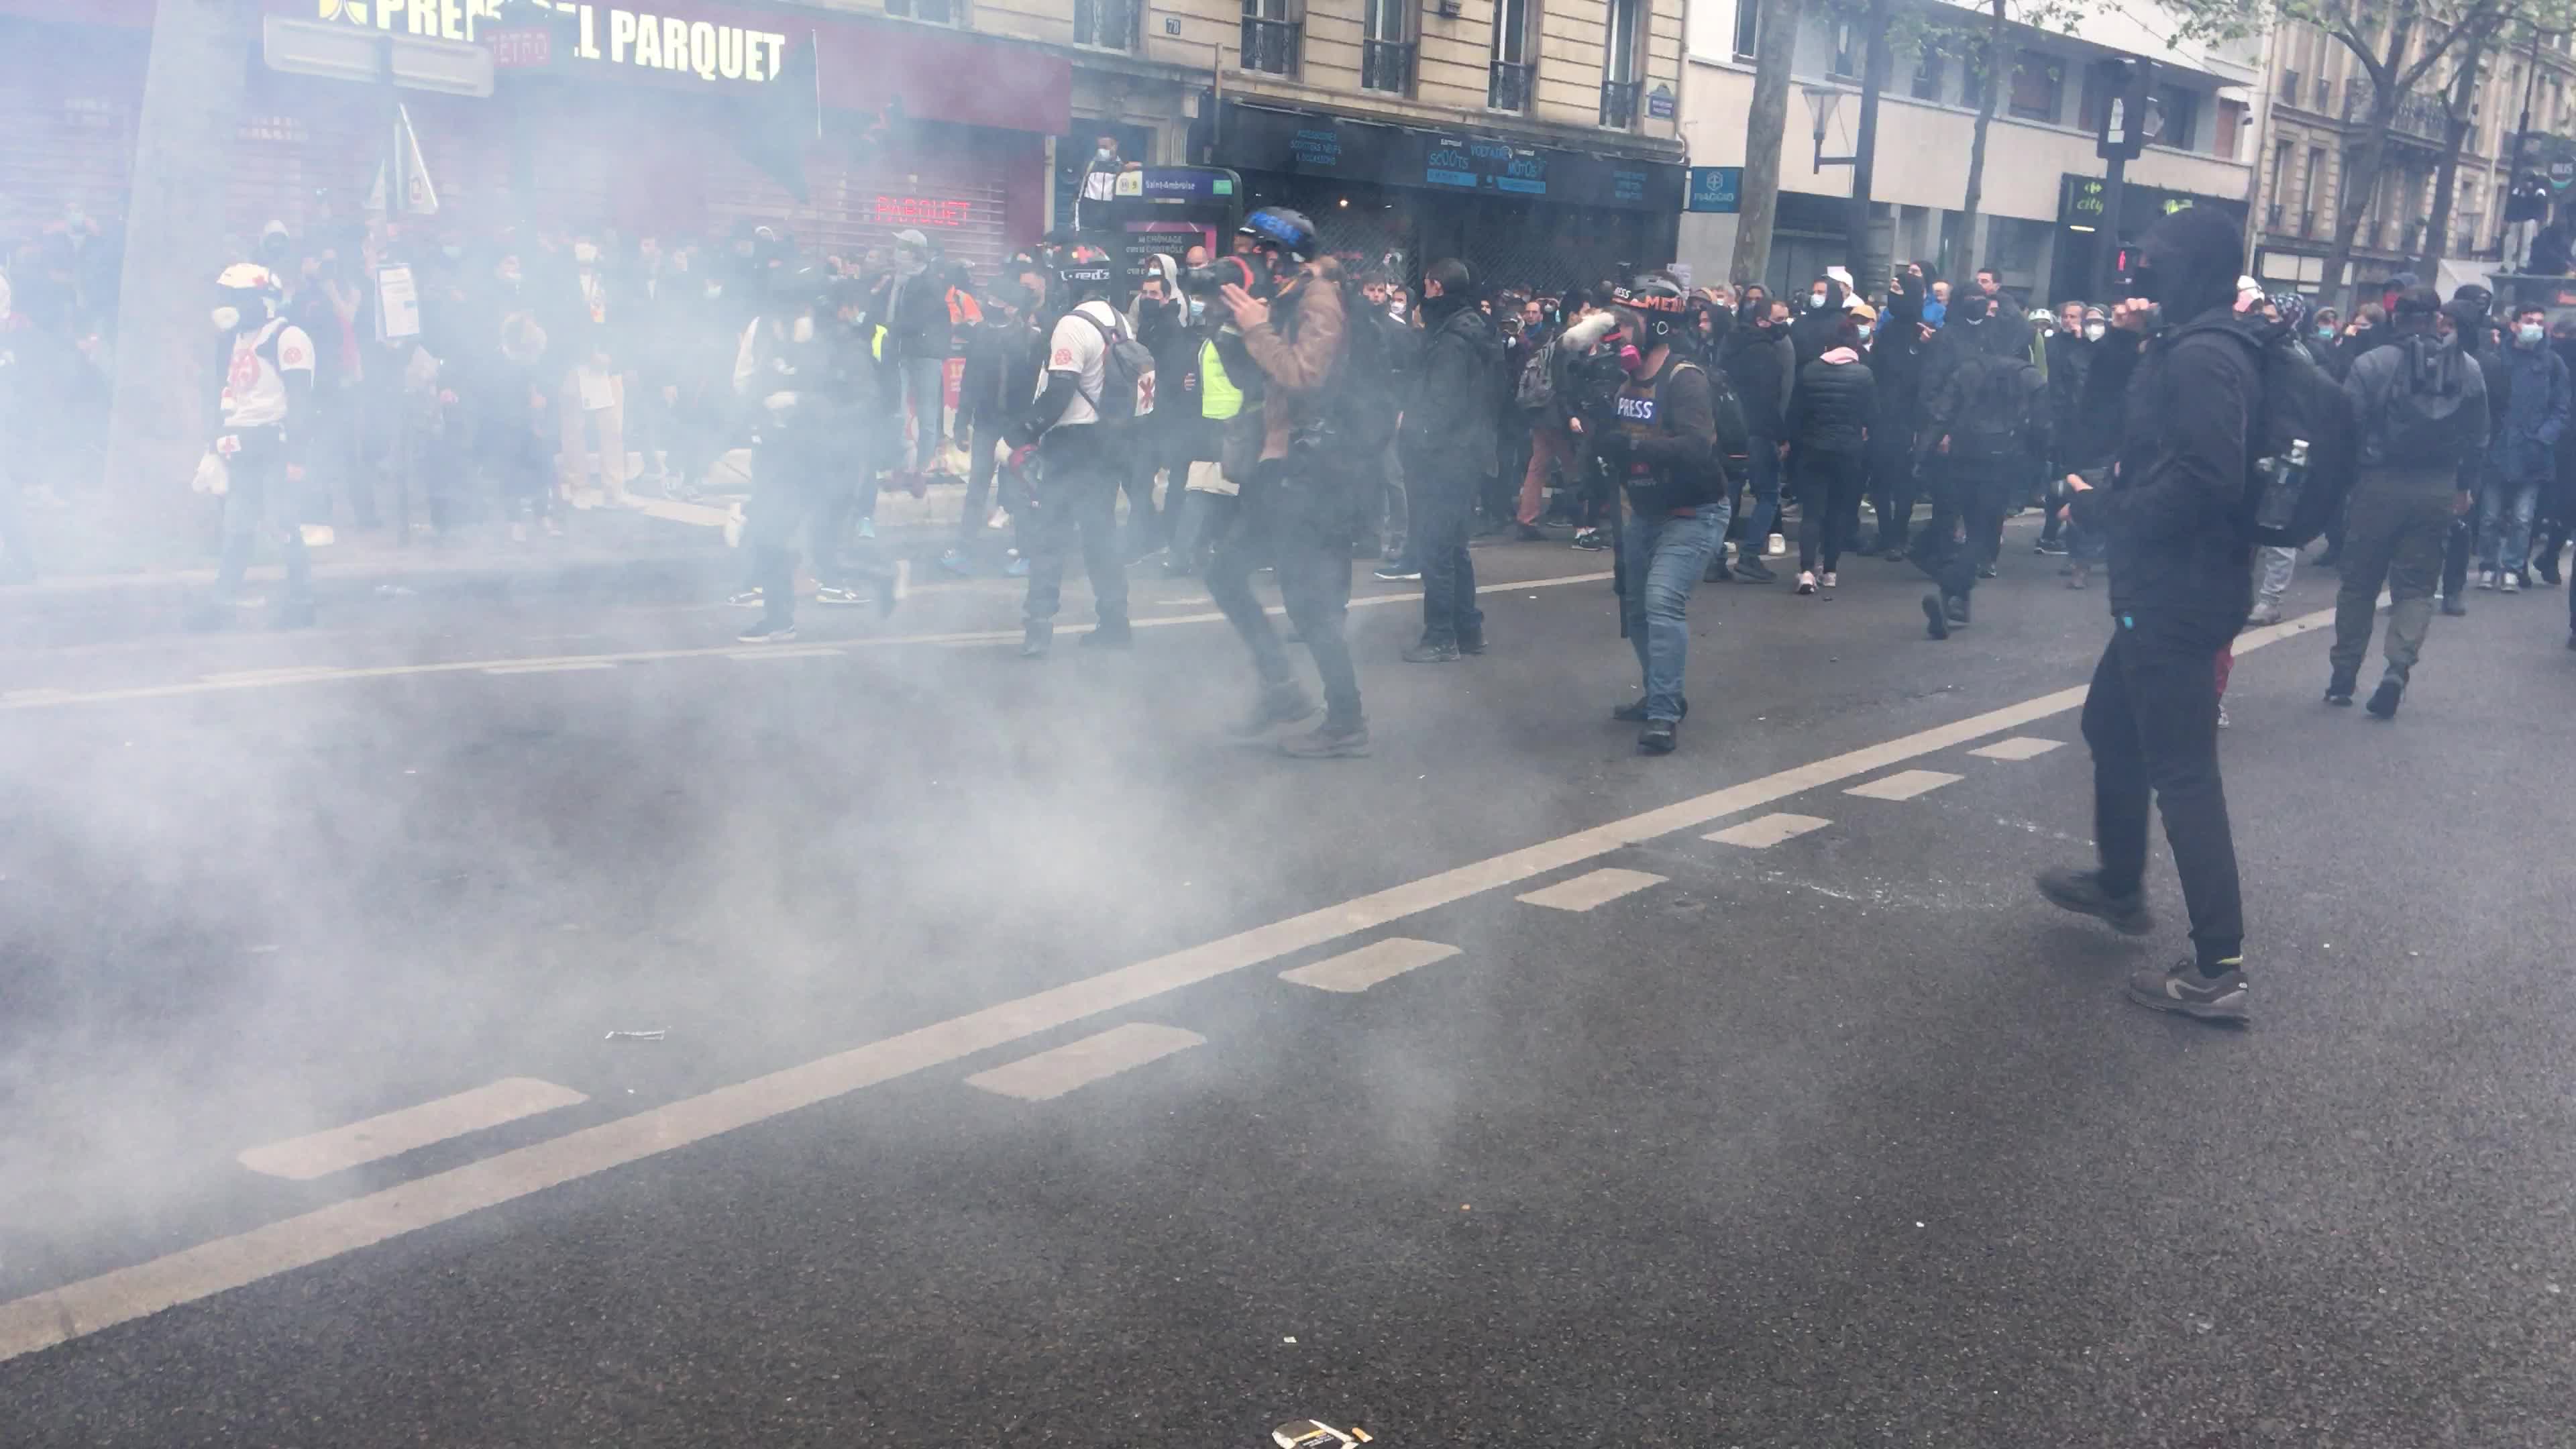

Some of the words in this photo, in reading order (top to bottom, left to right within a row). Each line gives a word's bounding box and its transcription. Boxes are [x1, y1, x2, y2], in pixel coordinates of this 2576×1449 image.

[1168, 20, 1179, 33] 78
[610, 9, 785, 81] PARQUET
[875, 195, 971, 227] PARQUET
[1617, 397, 1654, 419] PRESS
